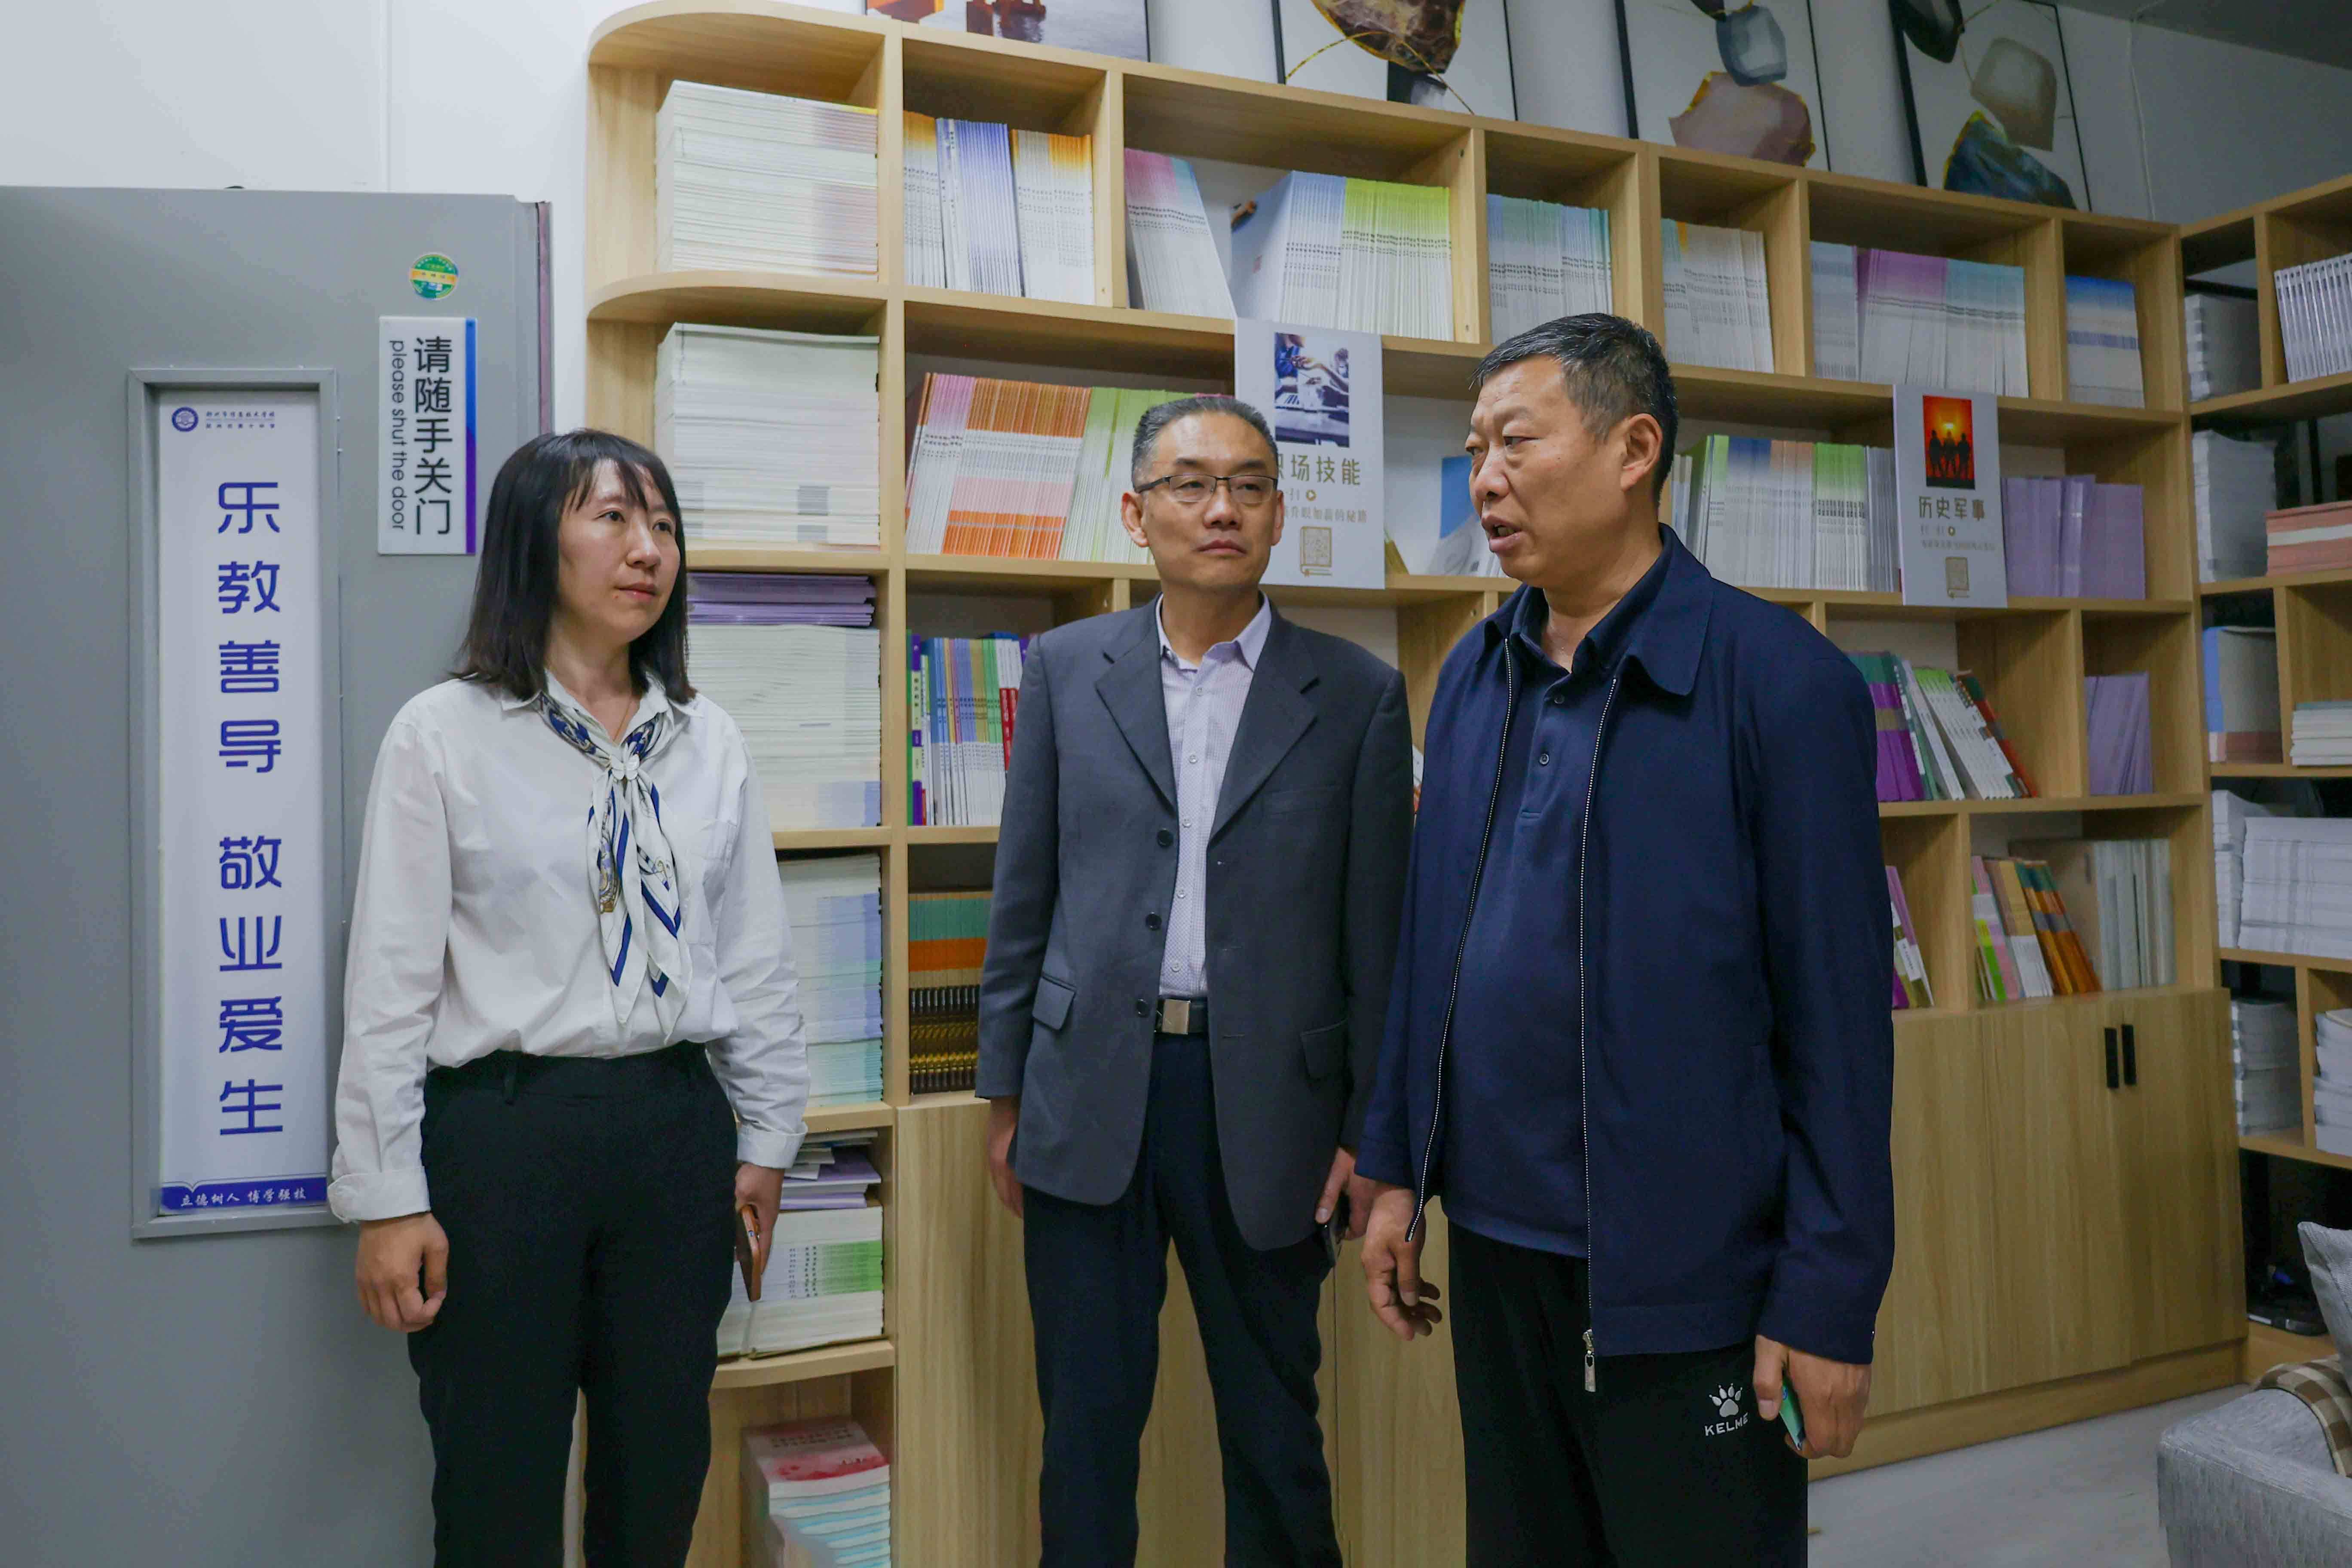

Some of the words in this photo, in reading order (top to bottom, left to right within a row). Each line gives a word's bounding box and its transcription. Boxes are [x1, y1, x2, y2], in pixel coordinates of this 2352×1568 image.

[389, 340, 407, 403] please
[392, 409, 407, 446] shut
[414, 336, 452, 535] 请随手关门
[392, 452, 407, 481] the
[392, 486, 407, 530] door
[1919, 496, 1985, 521] 历史军事
[218, 482, 281, 773] 乐教善导
[219, 835, 283, 1136] 敬业爱生
[181, 1193, 240, 1207] 立德树人
[1704, 1412, 1748, 1436] KELME
